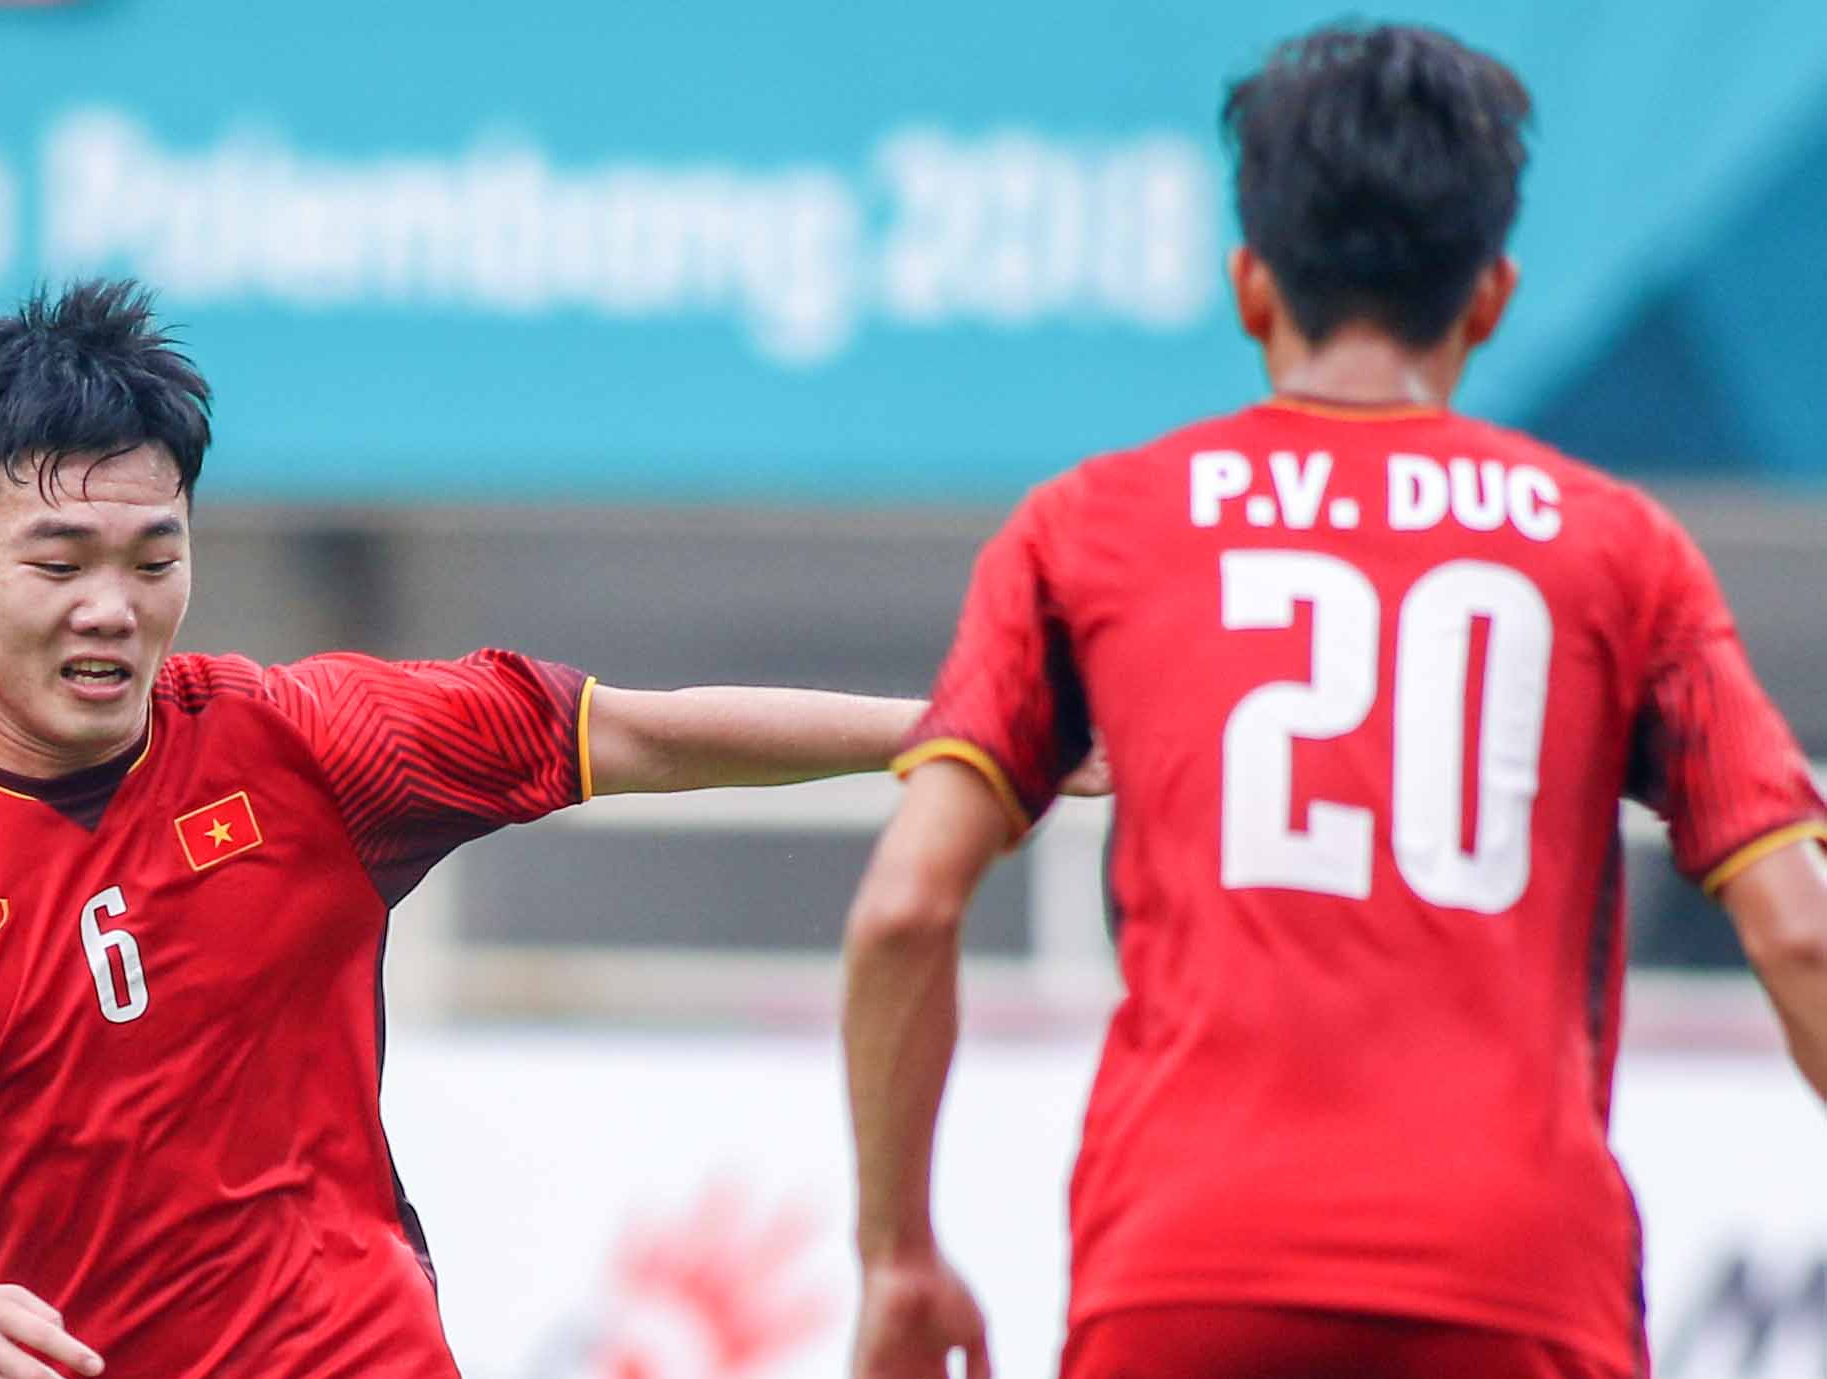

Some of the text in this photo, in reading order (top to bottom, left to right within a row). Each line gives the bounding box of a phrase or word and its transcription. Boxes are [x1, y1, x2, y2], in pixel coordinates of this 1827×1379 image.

[47, 112, 853, 358] Palembang
[875, 122, 1219, 328] 2018
[1189, 449, 1563, 542] P.V. DUC
[1219, 548, 1554, 916] 20
[79, 885, 150, 1024] 6
